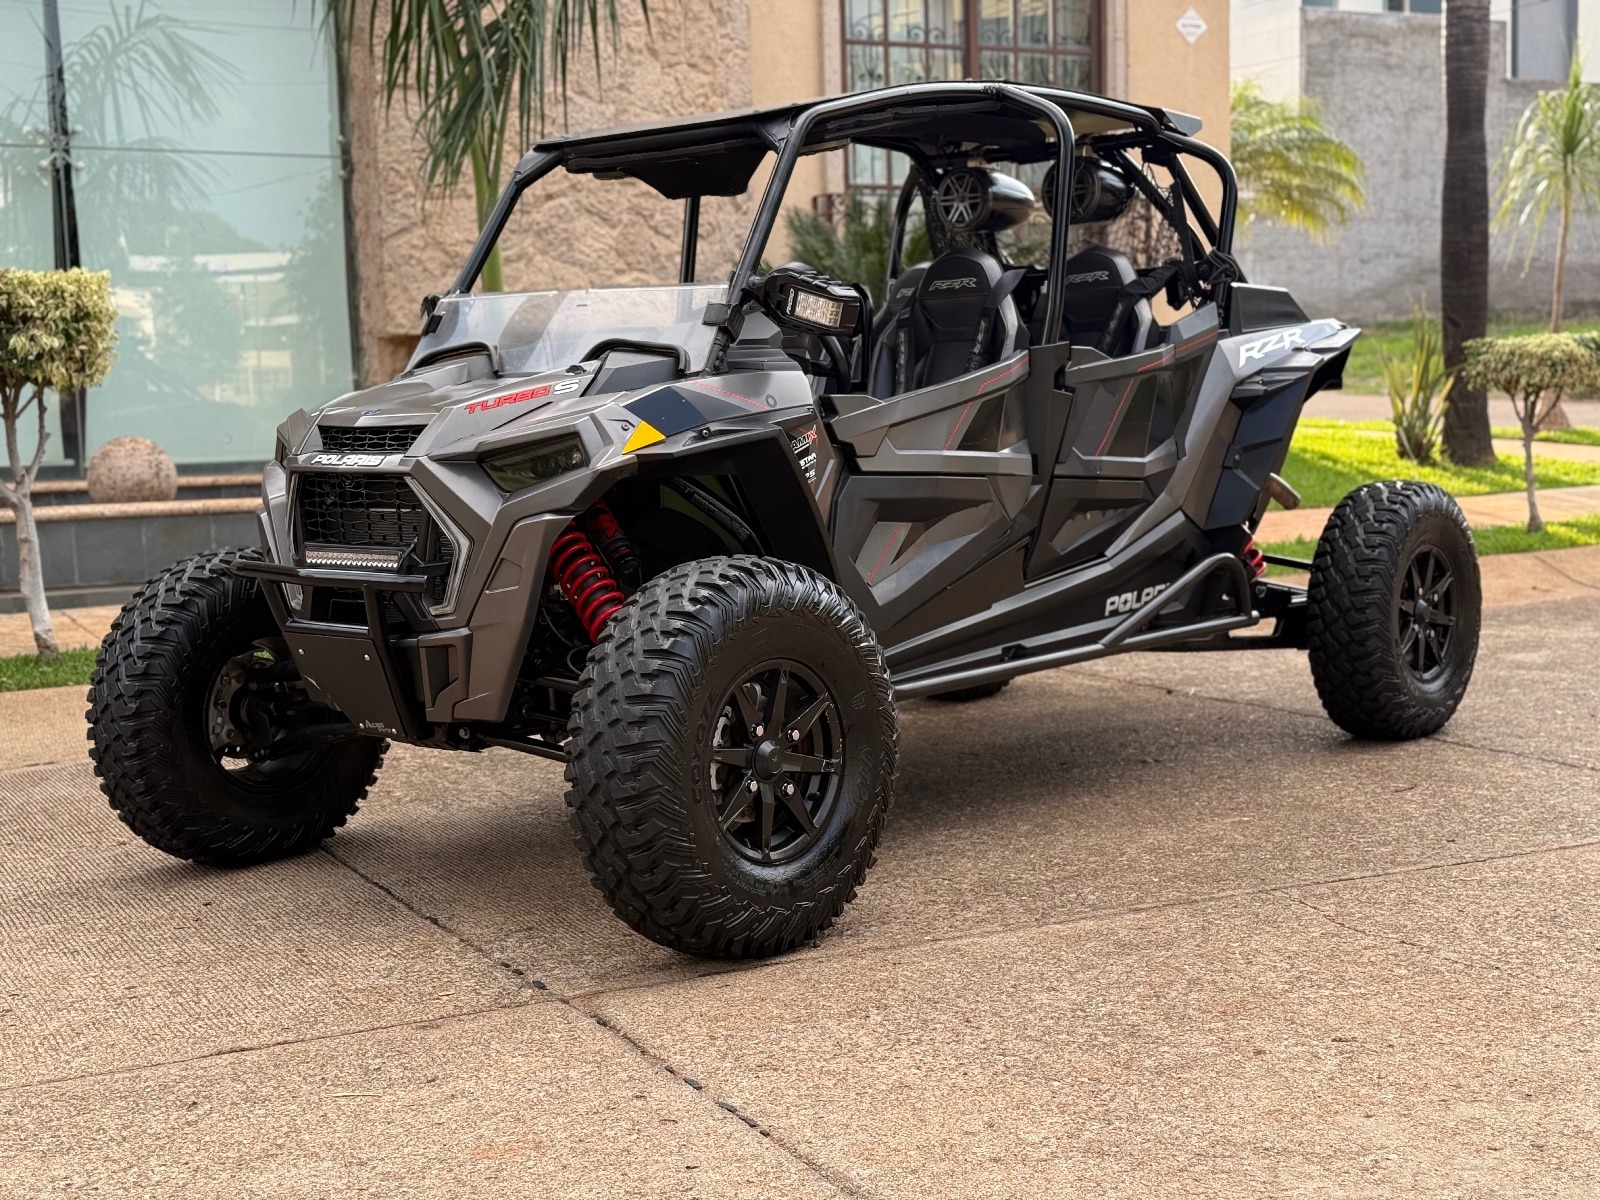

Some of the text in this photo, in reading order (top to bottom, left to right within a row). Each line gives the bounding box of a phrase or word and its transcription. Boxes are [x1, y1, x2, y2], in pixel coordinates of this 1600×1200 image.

[929, 277, 977, 291] RZR
[1238, 327, 1307, 368] RZR
[464, 379, 581, 414] TURBO S
[309, 454, 386, 468] POLARIS
